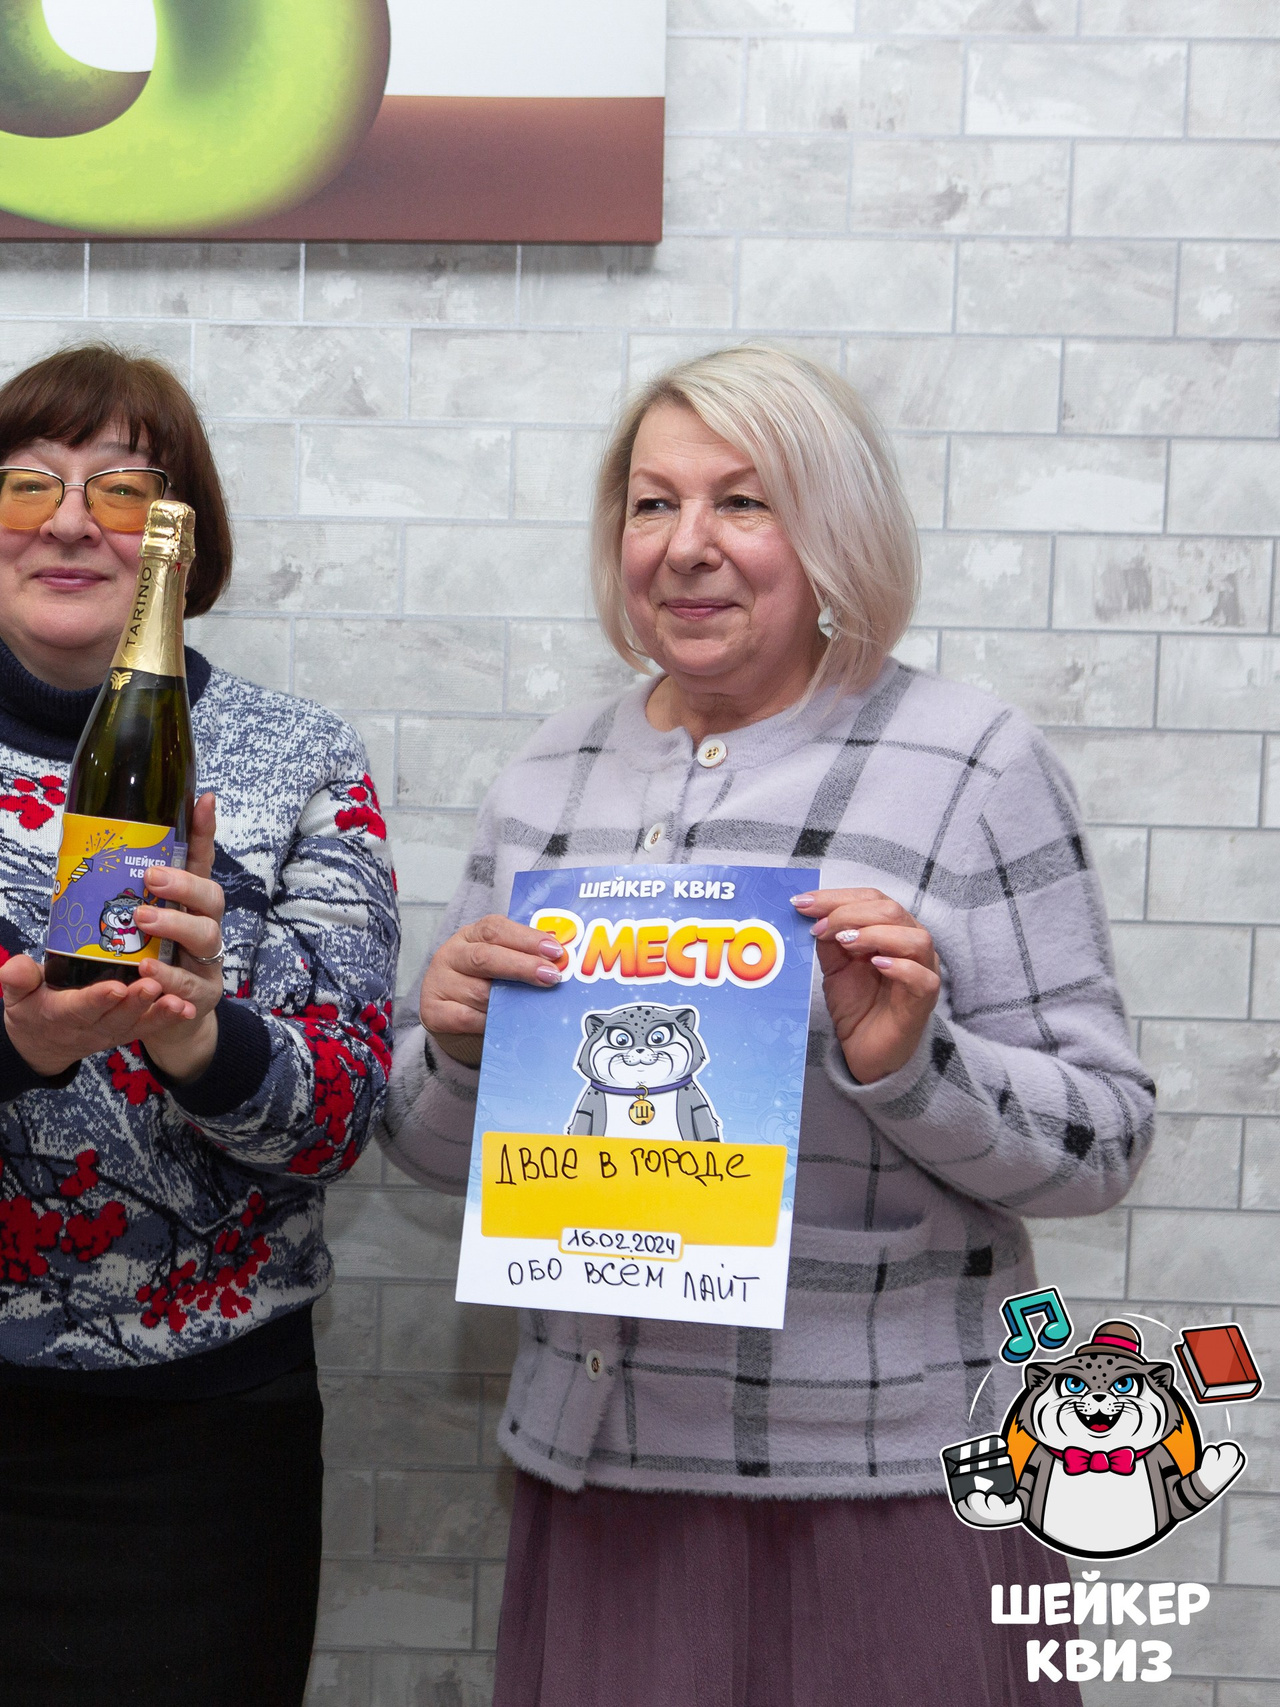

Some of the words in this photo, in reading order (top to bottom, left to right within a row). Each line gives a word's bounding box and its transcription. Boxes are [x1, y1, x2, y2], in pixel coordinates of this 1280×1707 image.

[125, 566, 152, 648] TARINO
[578, 876, 666, 898] ШЕЙКЕР
[673, 880, 736, 900] КВИЗ
[580, 925, 778, 982] МЕСТО
[635, 1105, 649, 1119] Ш
[567, 1229, 676, 1255] 16.02.2024
[508, 1258, 563, 1285] ОБО
[683, 1263, 761, 1303] ЛАЙТ
